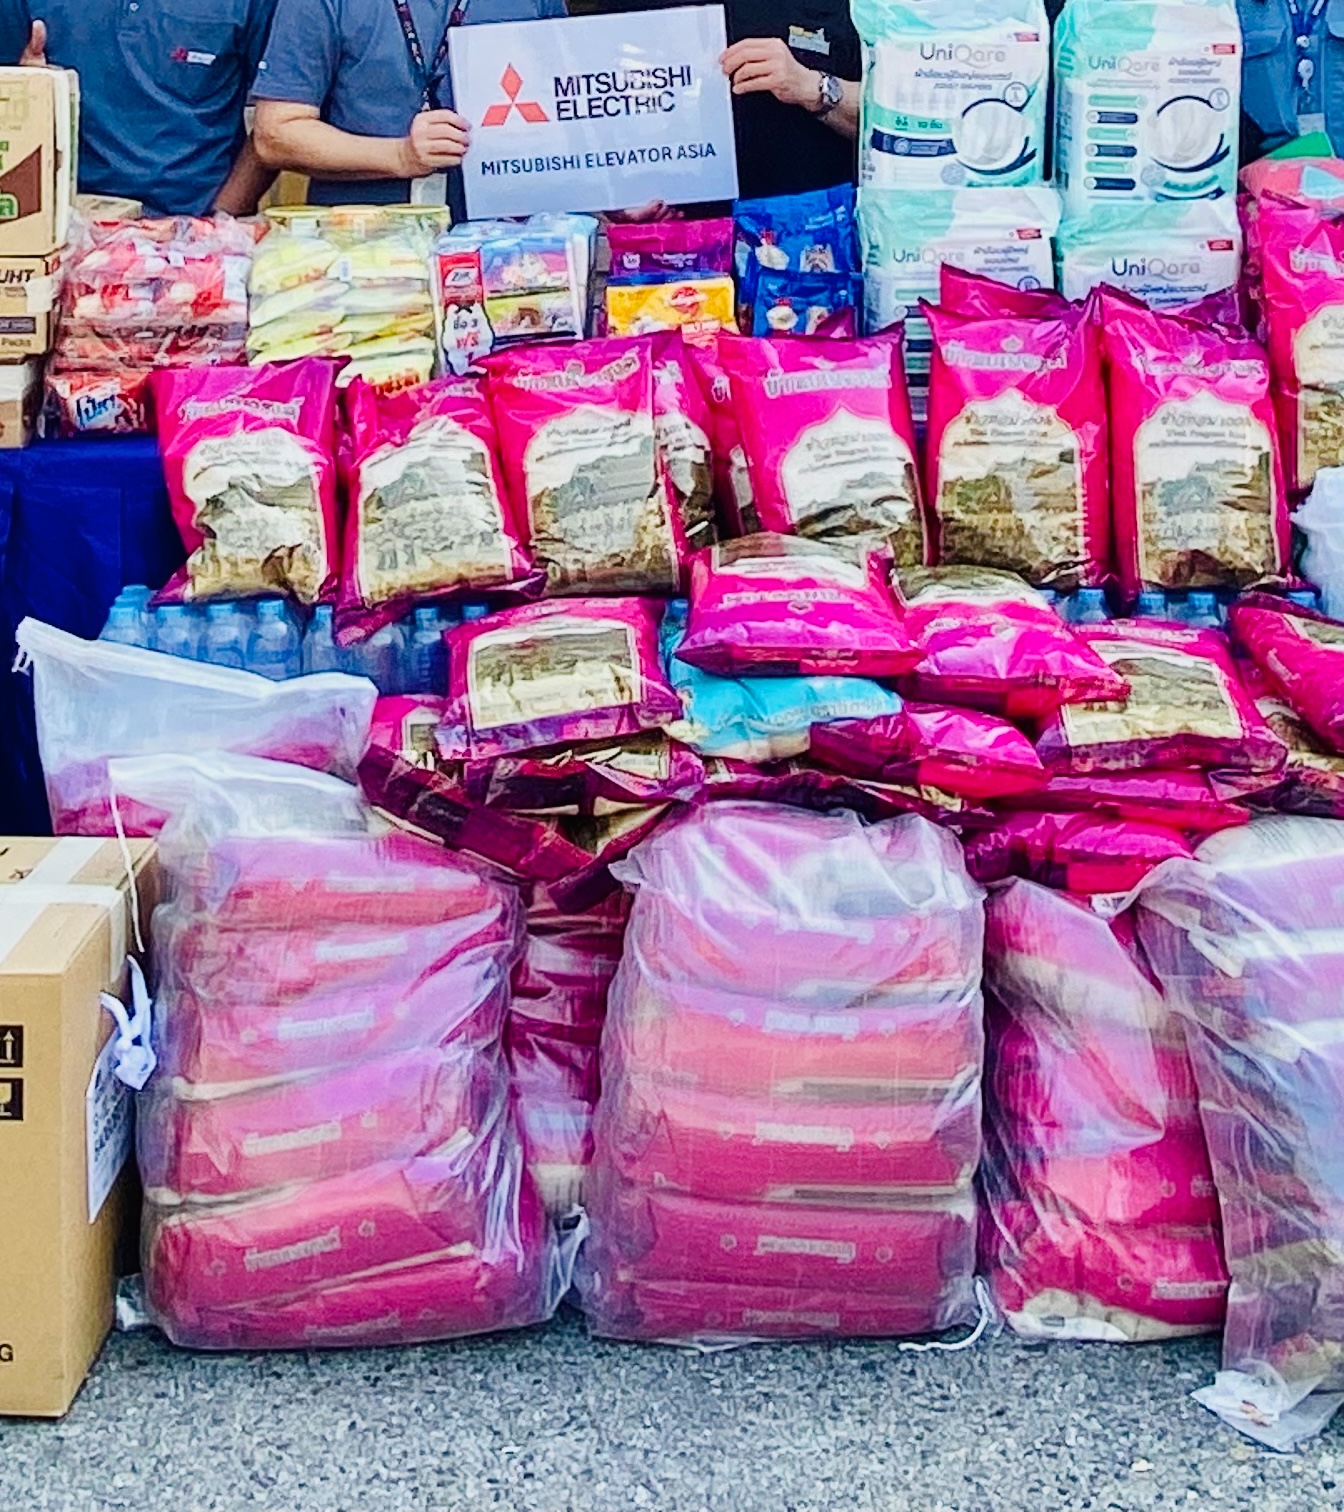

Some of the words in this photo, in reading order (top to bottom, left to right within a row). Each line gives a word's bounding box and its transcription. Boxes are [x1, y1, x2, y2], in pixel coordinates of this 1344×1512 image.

[920, 43, 1006, 69] UniQare
[1088, 55, 1160, 77] UniQare
[554, 63, 693, 98] MITSUBISHI
[556, 91, 676, 121] ELECTRIC
[481, 153, 582, 176] MITSUBISHI
[585, 145, 672, 168] ELEVATOR
[676, 142, 717, 161] ASIA
[892, 247, 964, 268] UniQare
[1111, 258, 1200, 281] UniQare
